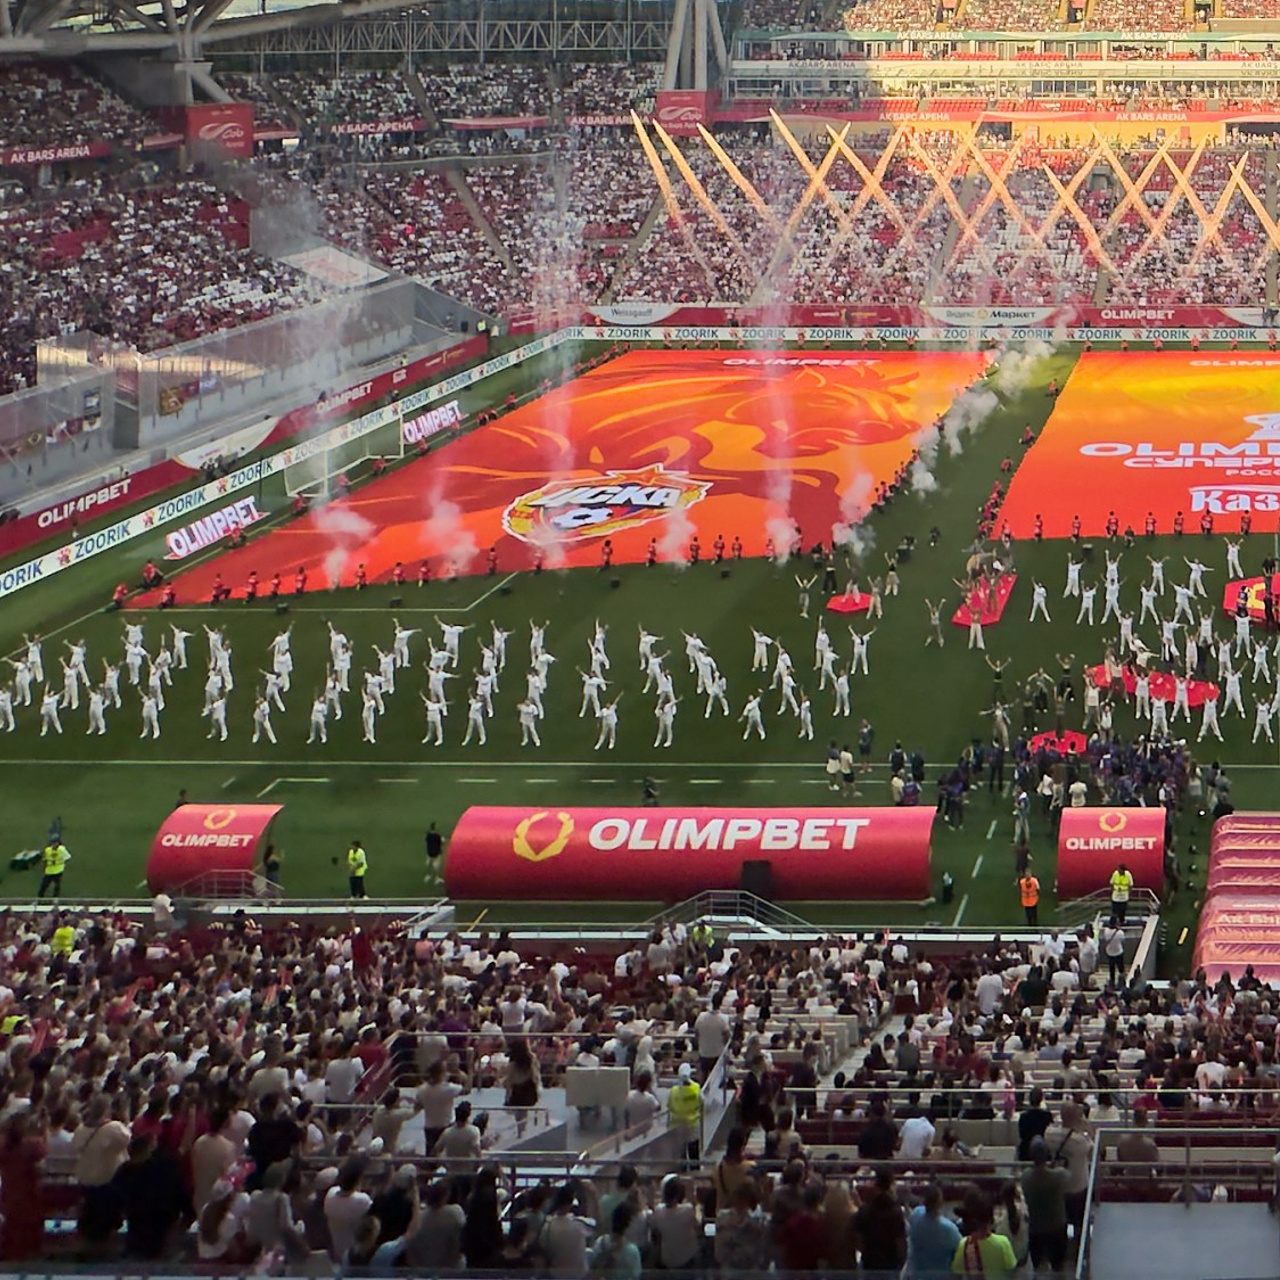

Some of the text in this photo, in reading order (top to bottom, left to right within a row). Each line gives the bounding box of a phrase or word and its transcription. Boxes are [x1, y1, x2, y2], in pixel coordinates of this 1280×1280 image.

[331, 121, 414, 133] АК БАРС АРЕНА
[615, 116, 649, 125] AREA
[11, 145, 90, 163] AK BARS ARENA
[990, 310, 1035, 319] Маркет
[1101, 309, 1175, 319] OLIMPBET
[607, 328, 652, 338] ZOORIK
[674, 328, 719, 338] ZOORIK
[809, 328, 853, 338] ZOORIK
[876, 328, 920, 338] ZOORIK
[1010, 328, 1054, 339] ZOORIK
[1078, 328, 1122, 339] ZOORIK
[1145, 329, 1190, 339] ZOORIK
[1213, 329, 1257, 339] ZOORIK
[401, 389, 431, 410] ZOORIK
[350, 410, 384, 433] ZOORIK
[404, 400, 462, 442] OLIMPBET
[230, 458, 273, 488] ZOORIK
[527, 485, 682, 508] ЦСКА
[38, 479, 131, 528] OLIMPBET
[157, 488, 206, 523] ZOORIK
[169, 495, 260, 556] OLIMPBET
[74, 522, 131, 559] ZOORIK
[162, 834, 253, 848] OLIMPBET
[589, 819, 870, 850] OLIMPBET
[1066, 837, 1157, 850] OLIMPBET
